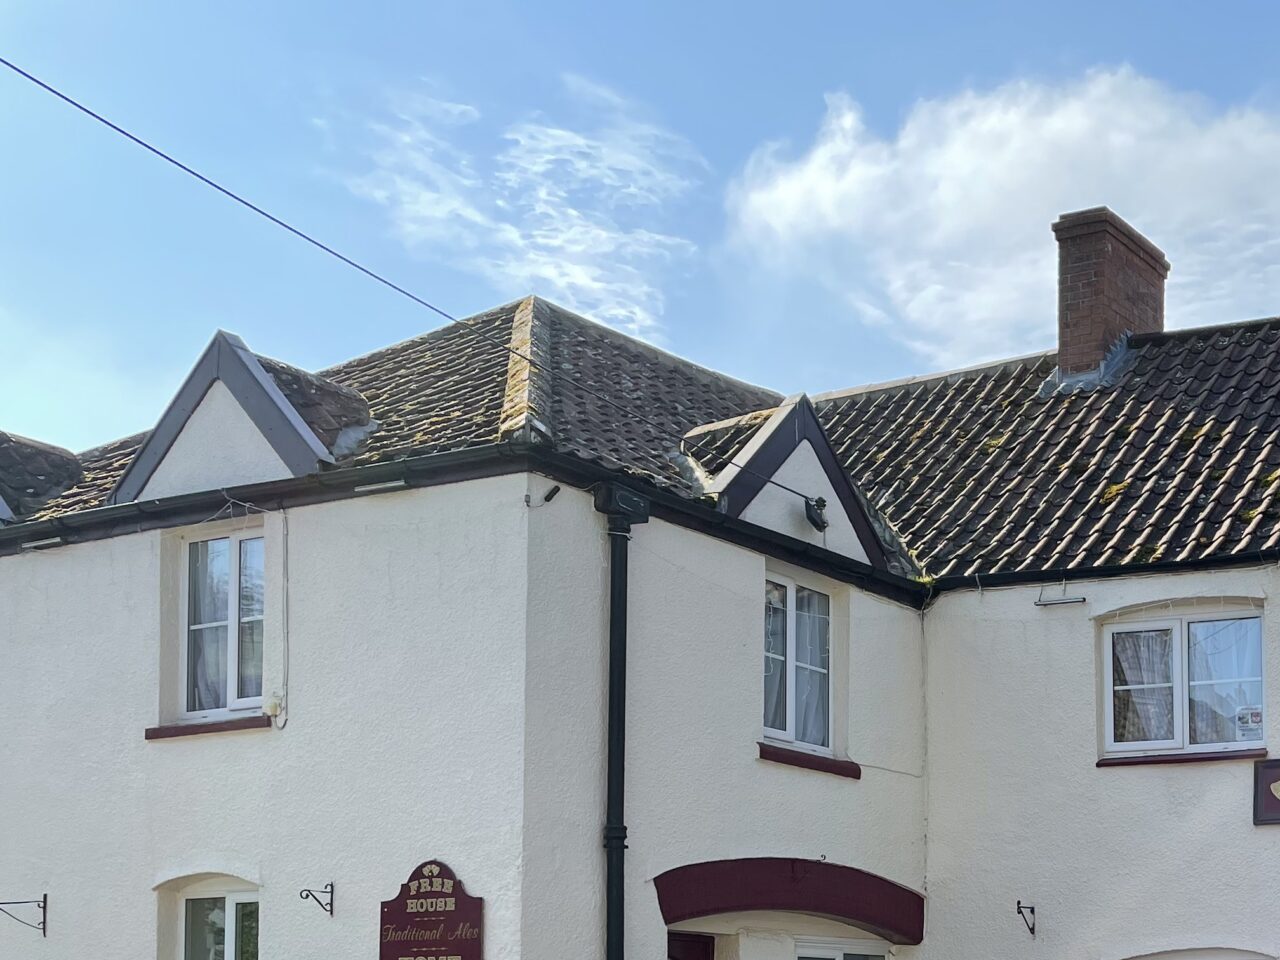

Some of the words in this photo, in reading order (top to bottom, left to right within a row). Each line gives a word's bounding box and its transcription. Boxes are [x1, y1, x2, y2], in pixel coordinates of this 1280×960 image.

[409, 877, 454, 895] FREE
[406, 897, 455, 913] HOUSE
[382, 922, 443, 944] Traditional
[448, 922, 479, 941] Ales
